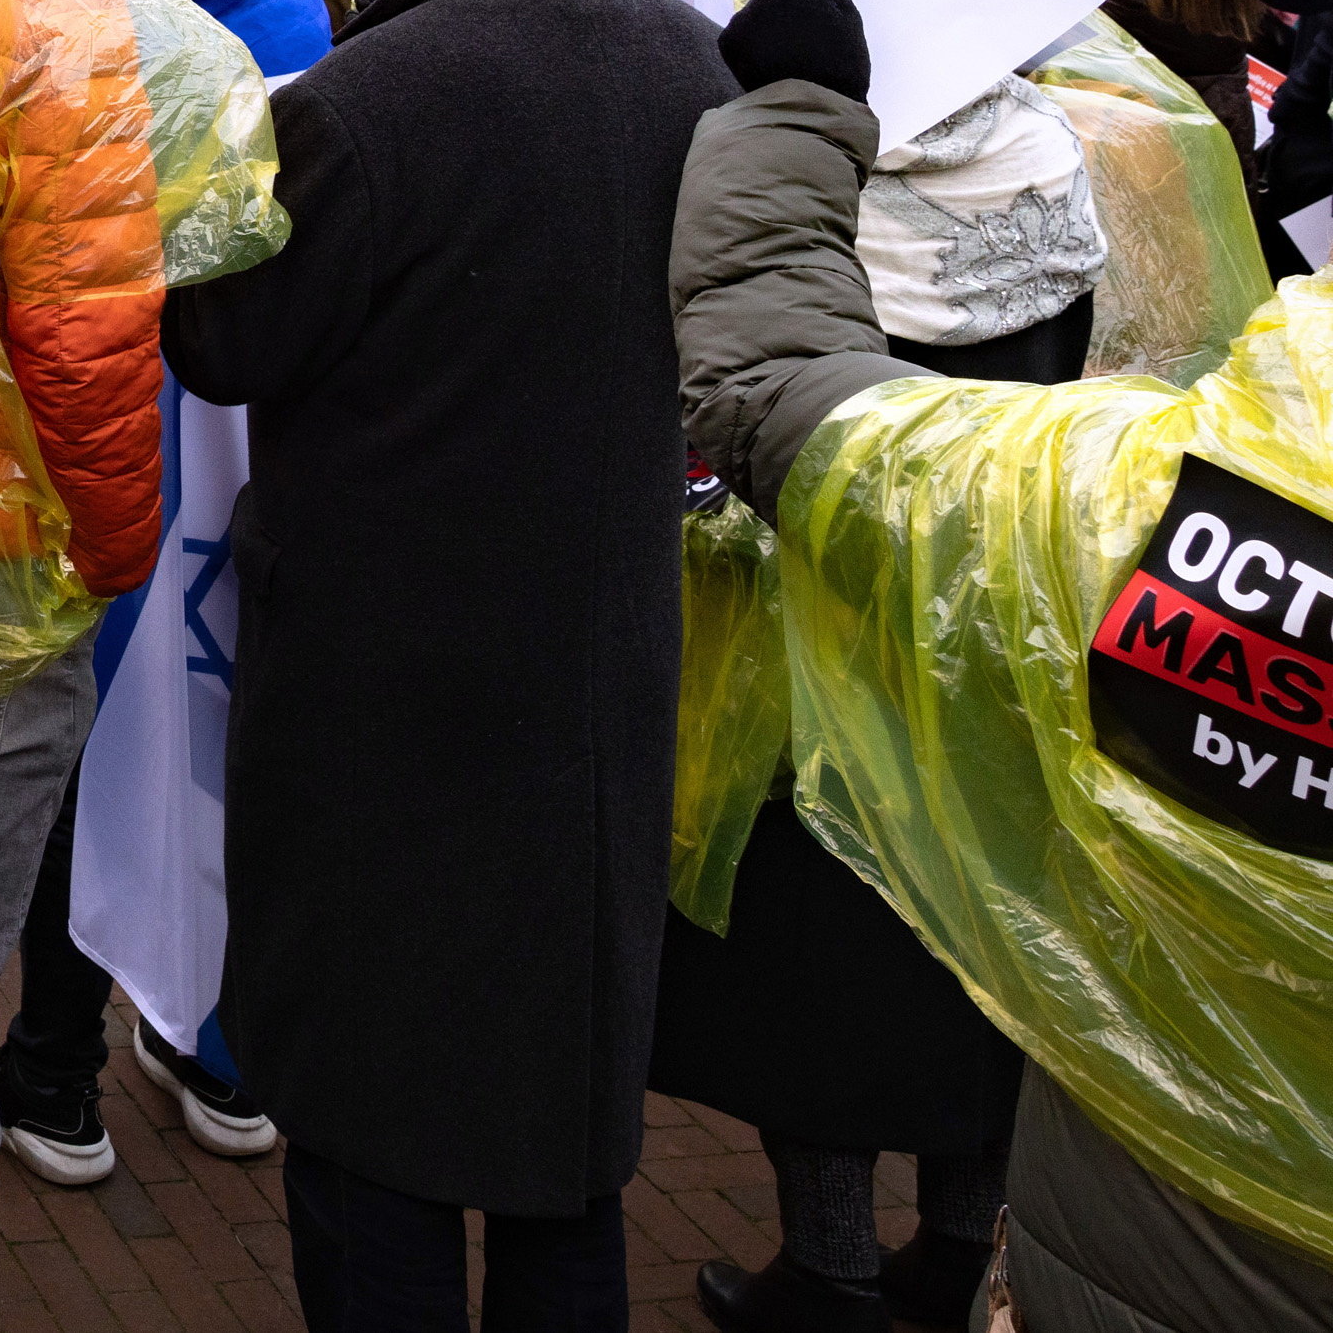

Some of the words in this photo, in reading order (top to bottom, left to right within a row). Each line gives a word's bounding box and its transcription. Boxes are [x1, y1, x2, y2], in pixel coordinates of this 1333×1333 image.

[1167, 511, 1333, 639] OCT
[1117, 587, 1333, 732] MAS
[1192, 713, 1279, 789] by
[1291, 755, 1333, 811] H
